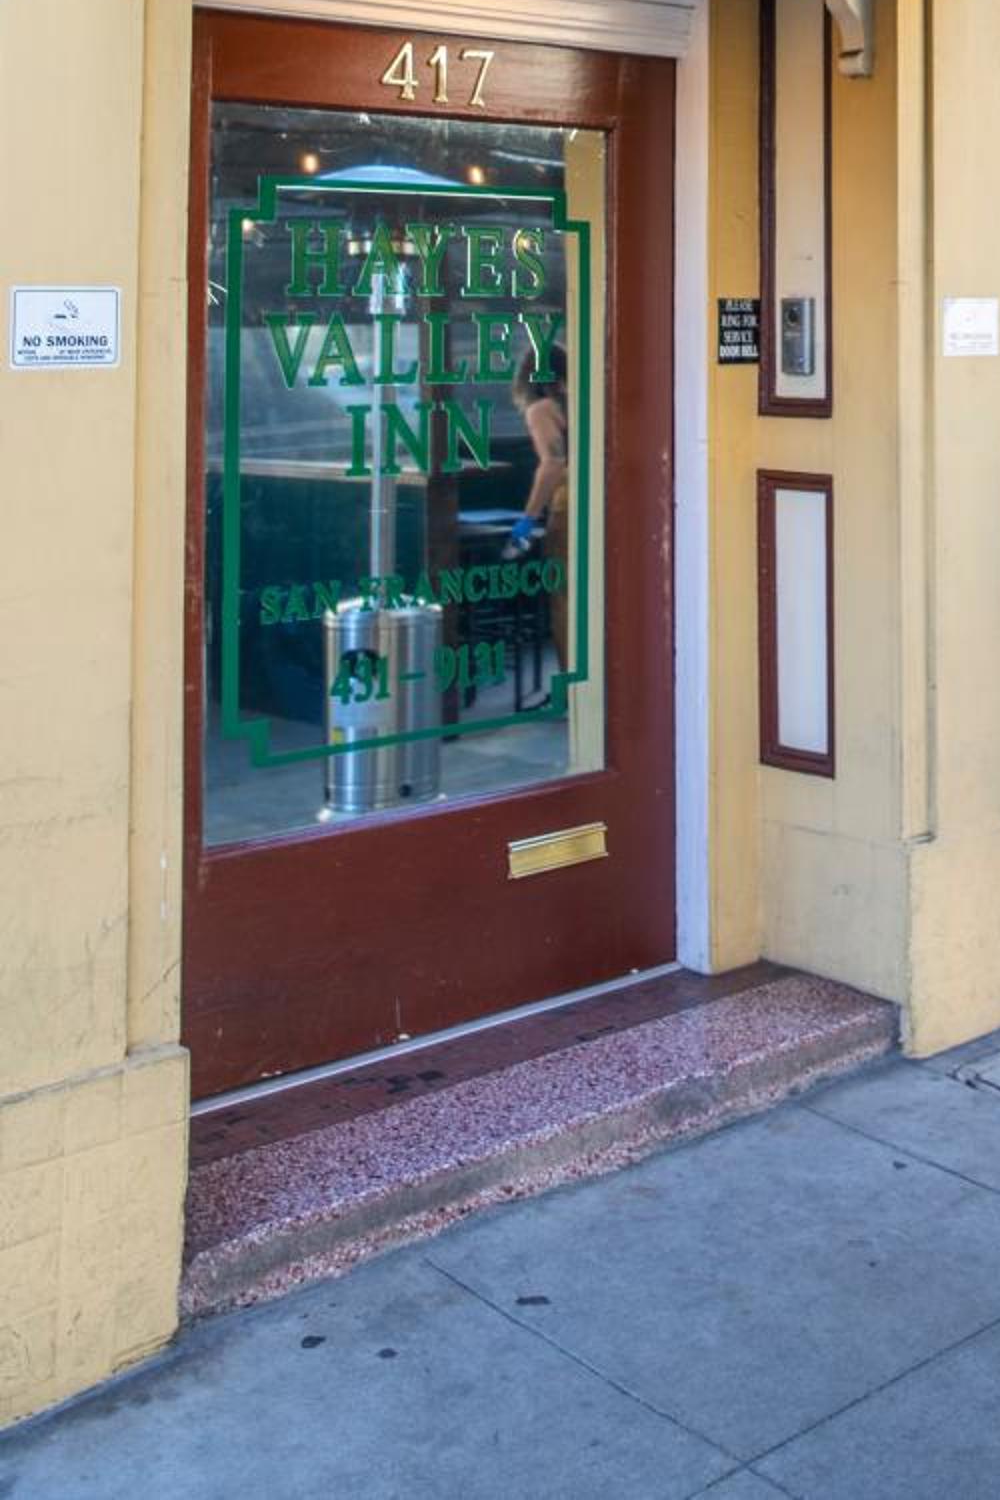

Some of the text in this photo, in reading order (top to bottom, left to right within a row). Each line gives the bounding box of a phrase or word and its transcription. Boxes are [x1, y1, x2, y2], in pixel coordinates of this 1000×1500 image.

[380, 41, 495, 107] 417
[285, 219, 547, 298] HAYES
[23, 335, 108, 347] NO SMOKING
[263, 310, 563, 390] VALLEY
[345, 400, 495, 477] INN
[259, 558, 565, 625] SAN FRANCISCO
